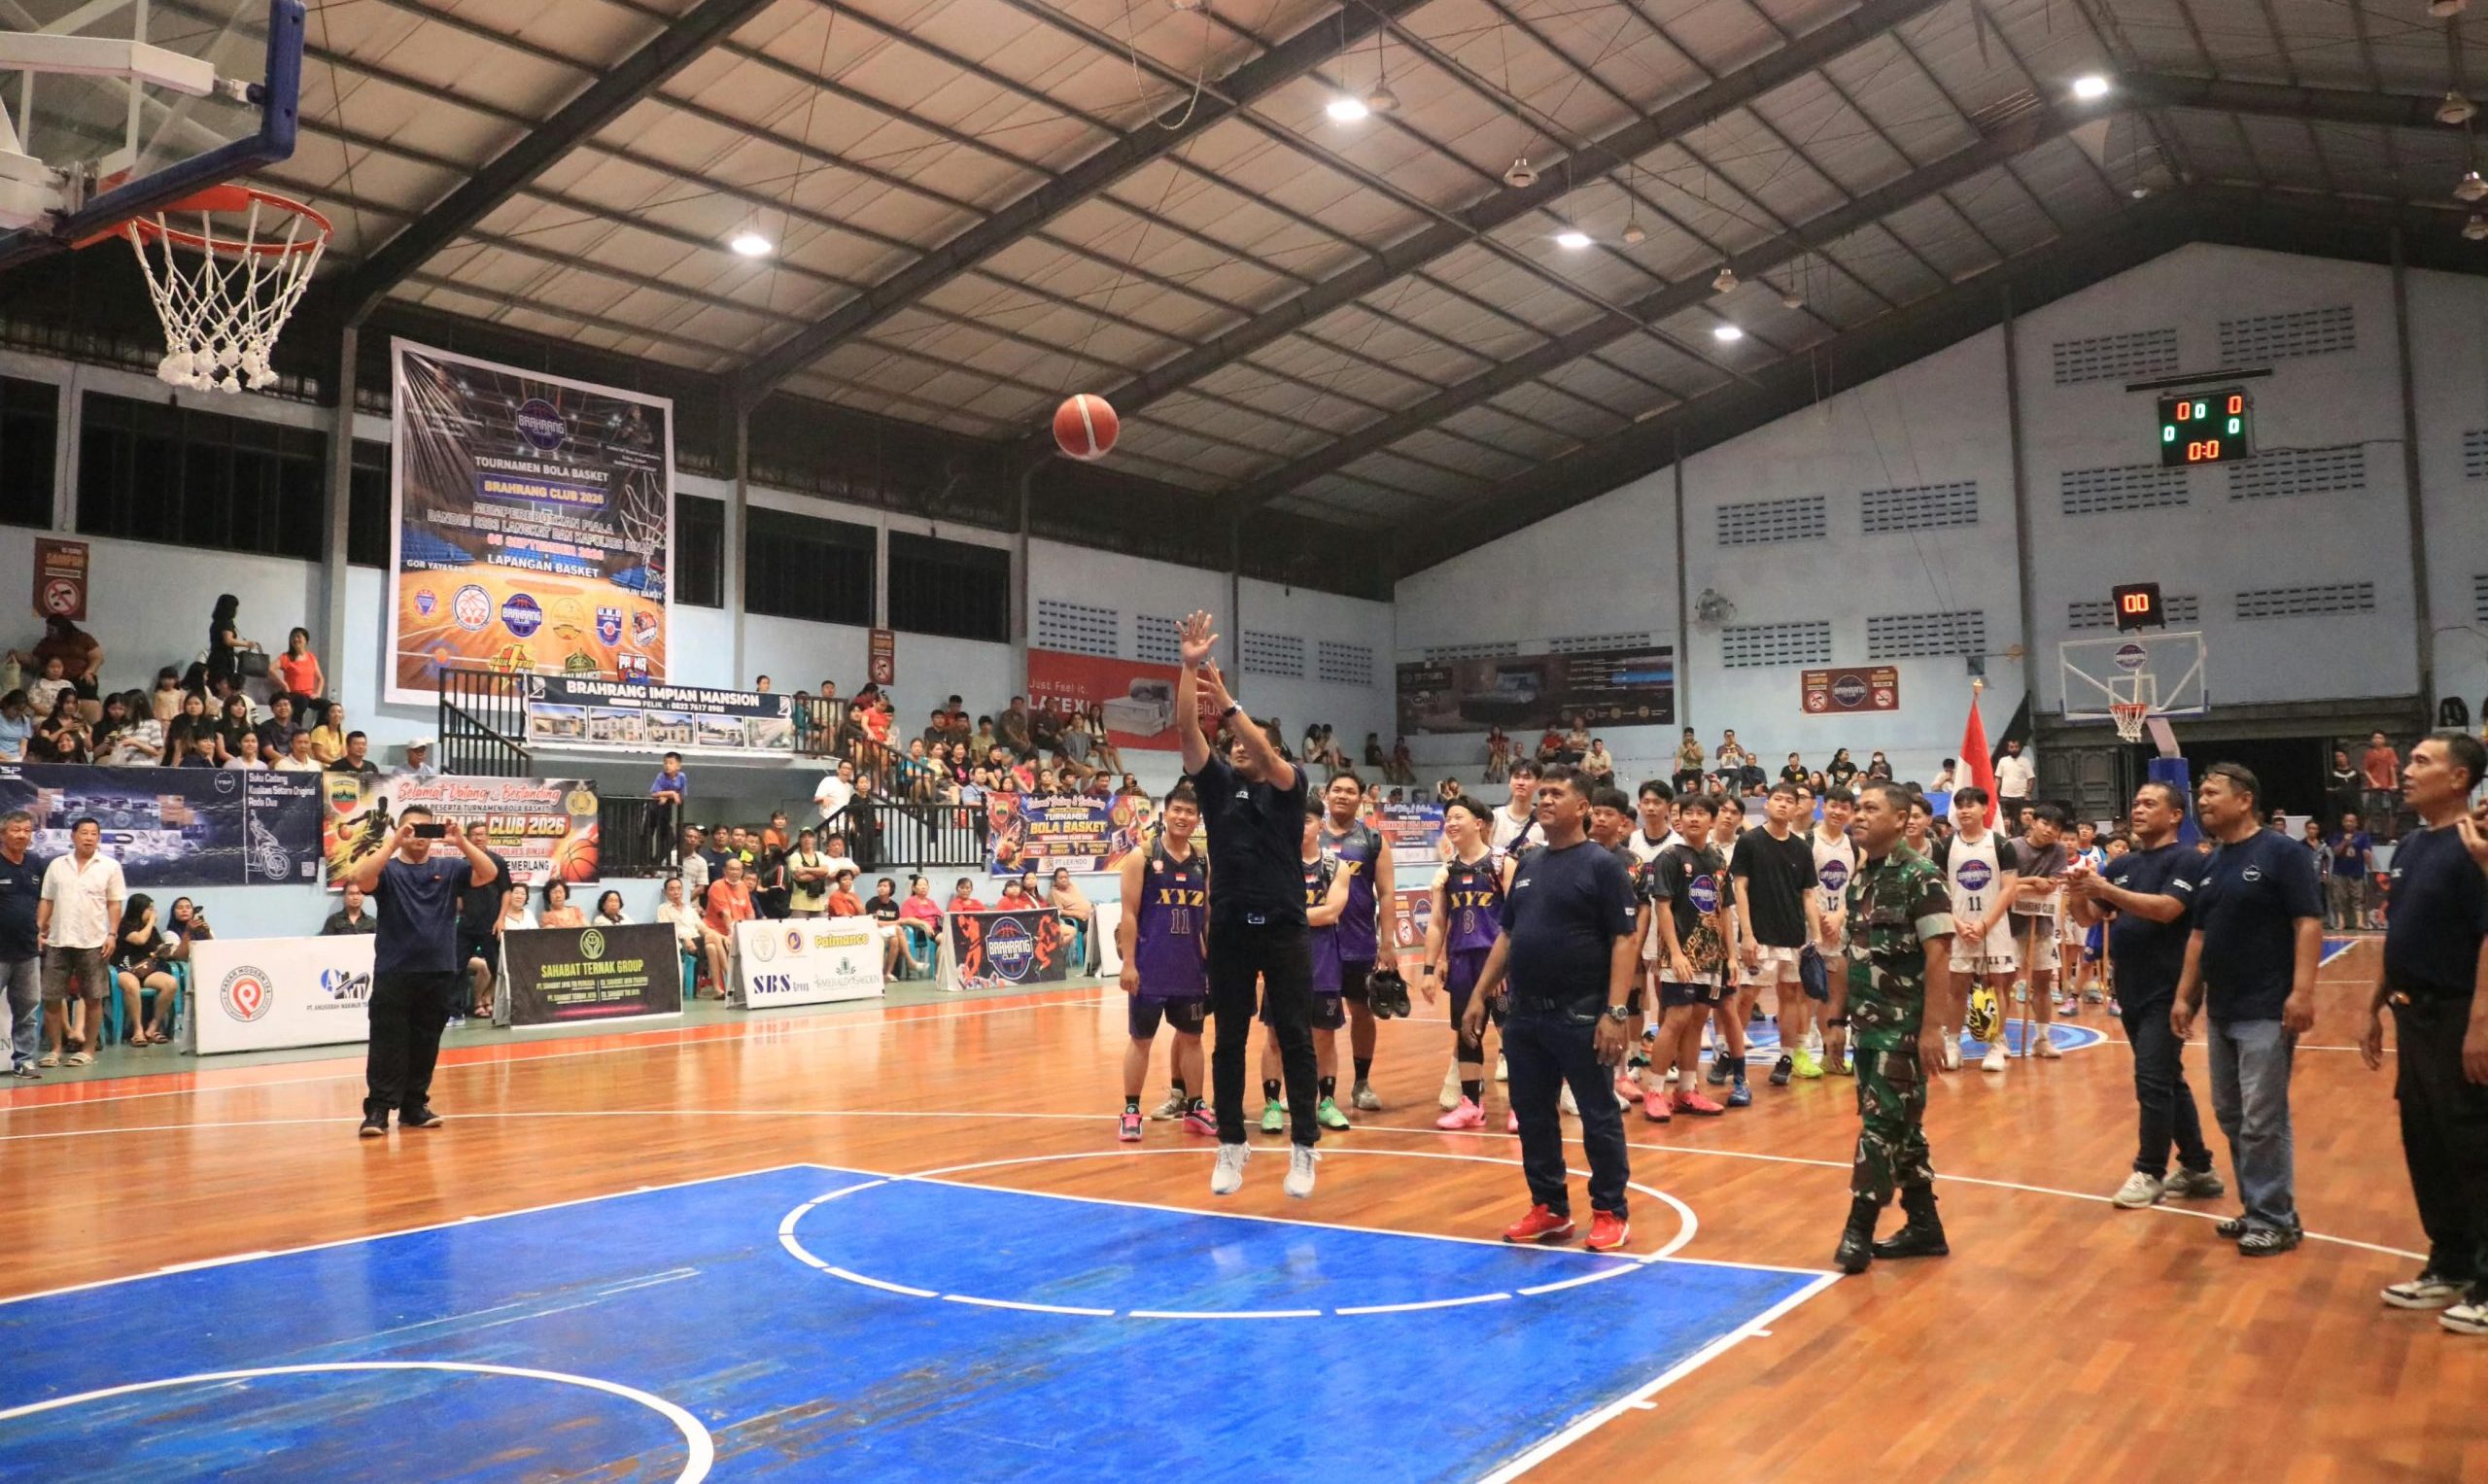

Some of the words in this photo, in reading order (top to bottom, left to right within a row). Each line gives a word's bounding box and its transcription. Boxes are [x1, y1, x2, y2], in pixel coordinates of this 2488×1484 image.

[2177, 402, 2191, 420] 0
[2194, 403, 2206, 419] 0
[2228, 396, 2242, 414] 0
[2163, 426, 2175, 442] 0
[2228, 418, 2240, 434] 0
[2189, 439, 2220, 461] 0:0
[474, 456, 540, 474] TOURNAMEN
[543, 463, 570, 476] BOLA
[571, 467, 608, 482] BASKET
[484, 479, 547, 499] BRAHRANG
[550, 488, 578, 501] CLUB
[406, 559, 426, 569] GOR
[488, 553, 553, 573] LAPANGAN
[556, 563, 600, 578] BASKET
[2124, 594, 2149, 613] 00
[567, 679, 645, 699] BRAHRANG
[649, 686, 699, 703] IMPIAN
[700, 690, 760, 707] MANSION
[1029, 677, 1051, 691] Just
[1055, 680, 1074, 693] Feel
[1197, 702, 1223, 717] elux
[249, 773, 264, 782] Suku
[265, 774, 289, 785] Cadang
[294, 786, 316, 798] Original
[397, 781, 449, 803] Selamat
[450, 781, 490, 802] Datang
[502, 782, 562, 805] Bertanding
[488, 815, 525, 837] CLUB
[528, 816, 567, 837] 2026
[1030, 822, 1060, 834] BOLA
[1063, 821, 1106, 834] BASKET
[506, 860, 550, 871] EMERLANG
[1155, 888, 1205, 907] XYZ
[1968, 896, 1982, 912] 11
[1170, 909, 1190, 934] 11
[988, 939, 1031, 956] BRAHRANG
[540, 963, 581, 979] SAHABAT
[583, 961, 616, 976] TERNAK
[616, 959, 643, 973] GROUP
[753, 974, 791, 994] SBS
